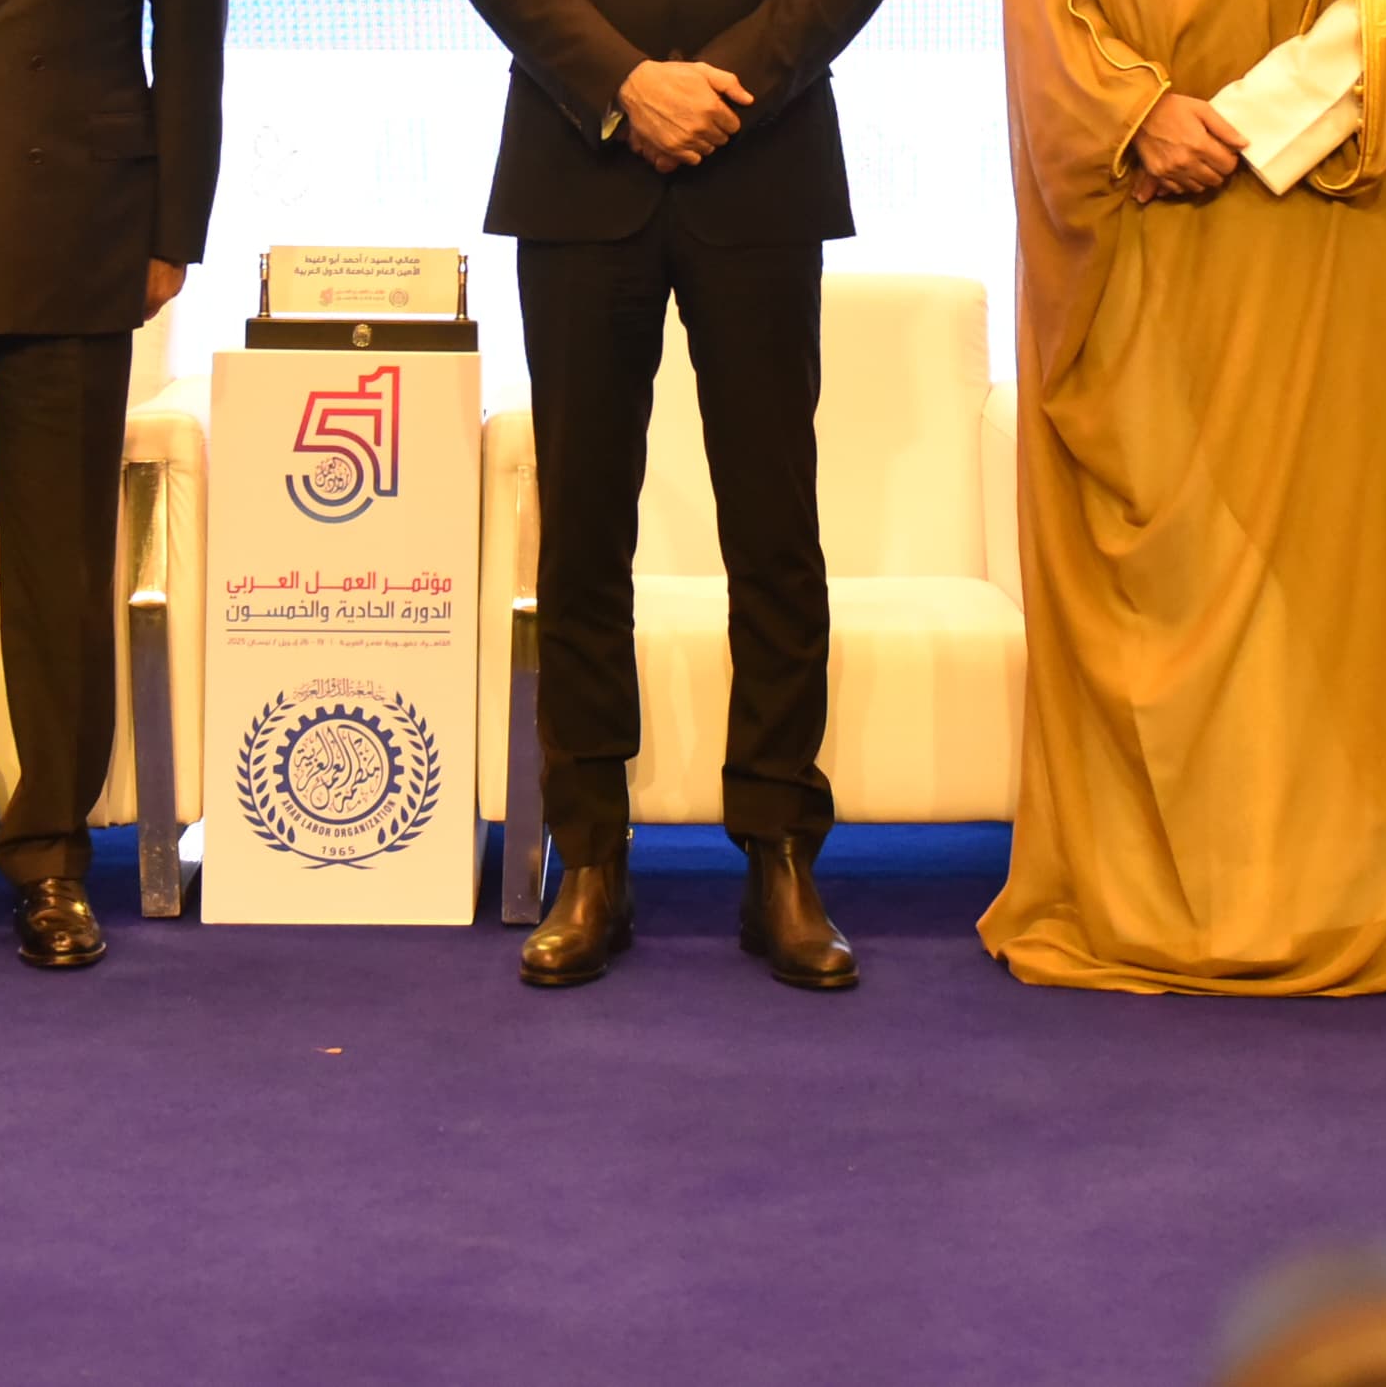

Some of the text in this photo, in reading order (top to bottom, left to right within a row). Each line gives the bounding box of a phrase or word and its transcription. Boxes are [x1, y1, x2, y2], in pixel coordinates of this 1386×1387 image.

[226, 570, 452, 599] مؤتمر العمل العربي
[225, 599, 452, 624] الدورة الحادية والخمسون
[281, 798, 397, 839] ARAB LABOR ORGANIZATION
[321, 845, 356, 856] 1965
